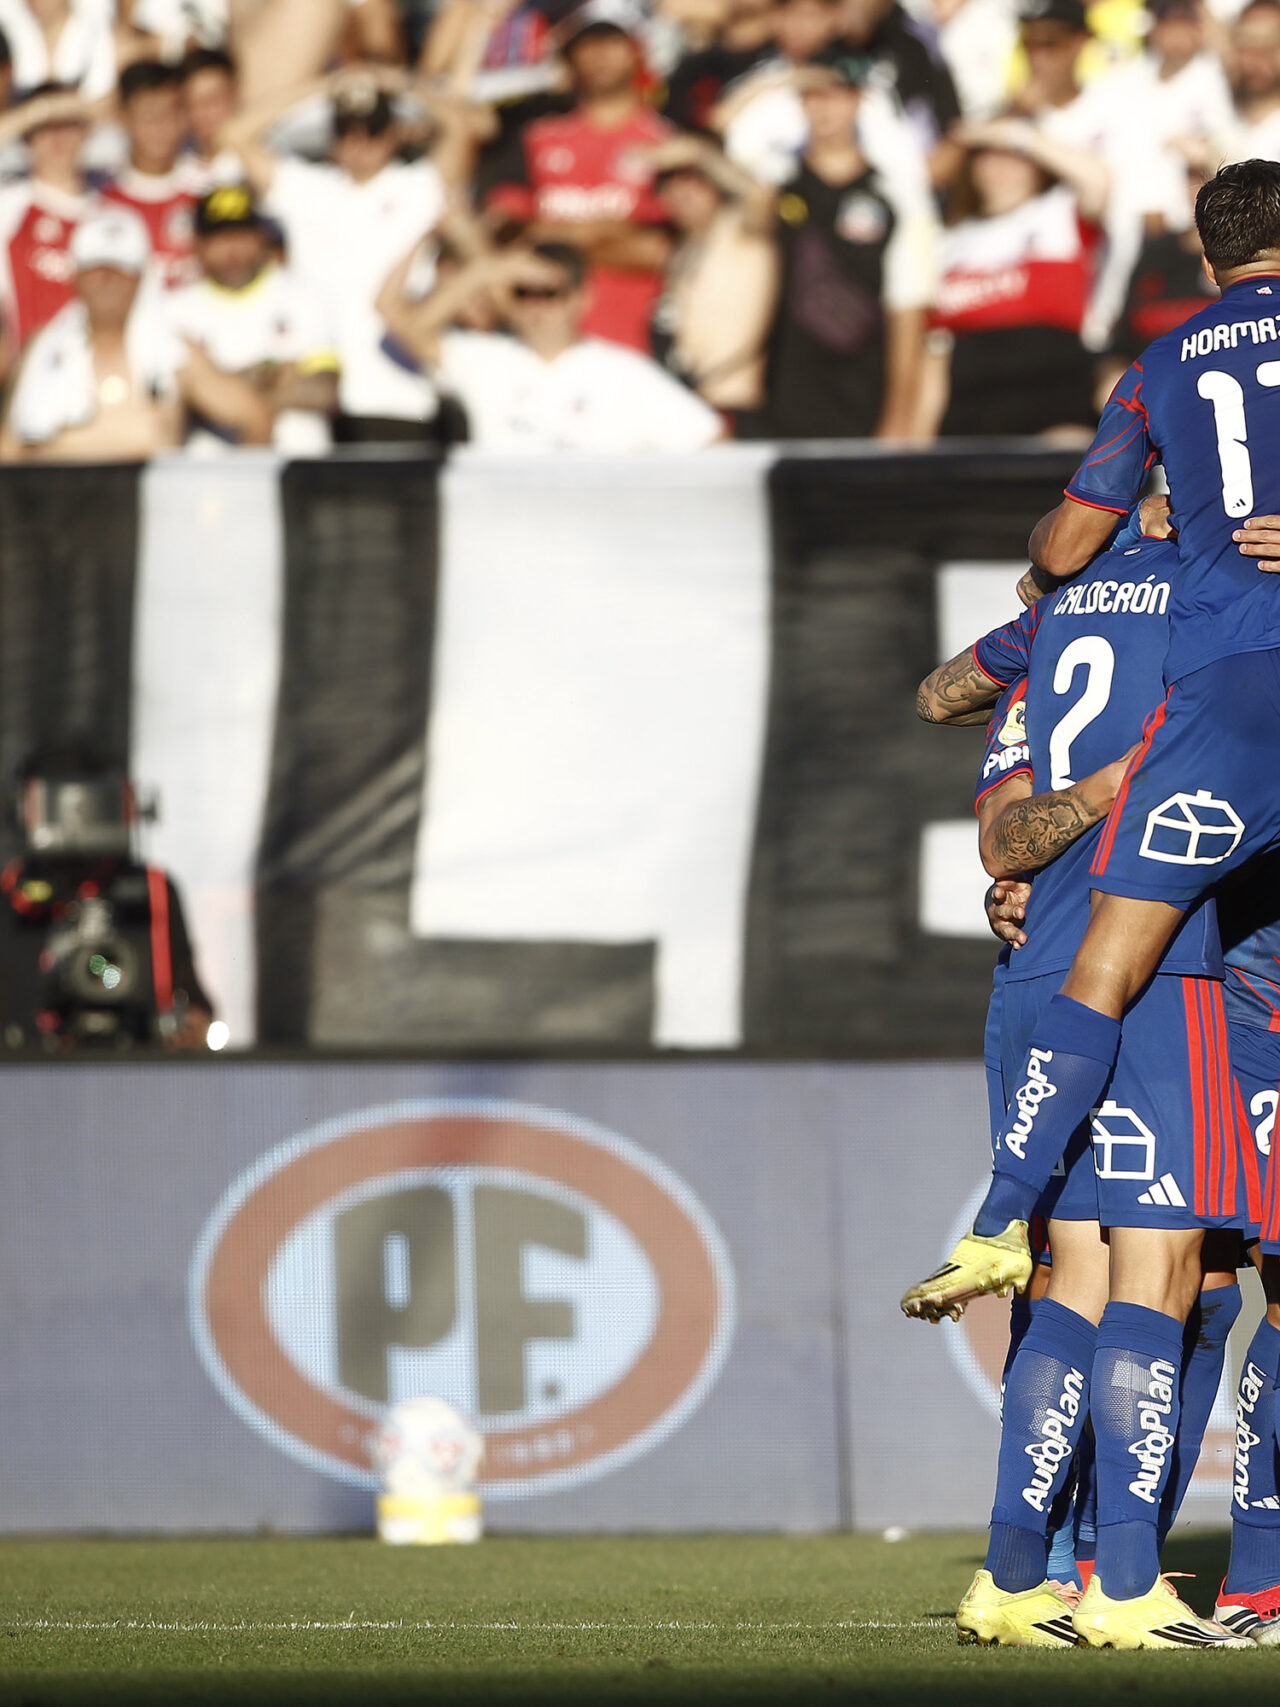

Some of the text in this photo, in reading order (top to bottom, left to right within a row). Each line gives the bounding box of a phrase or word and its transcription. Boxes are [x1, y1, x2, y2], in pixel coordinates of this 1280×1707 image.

[1053, 574, 1171, 616] CALDERÓN
[1049, 635, 1115, 791] 2
[1128, 1357, 1176, 1503] AutoPlan
